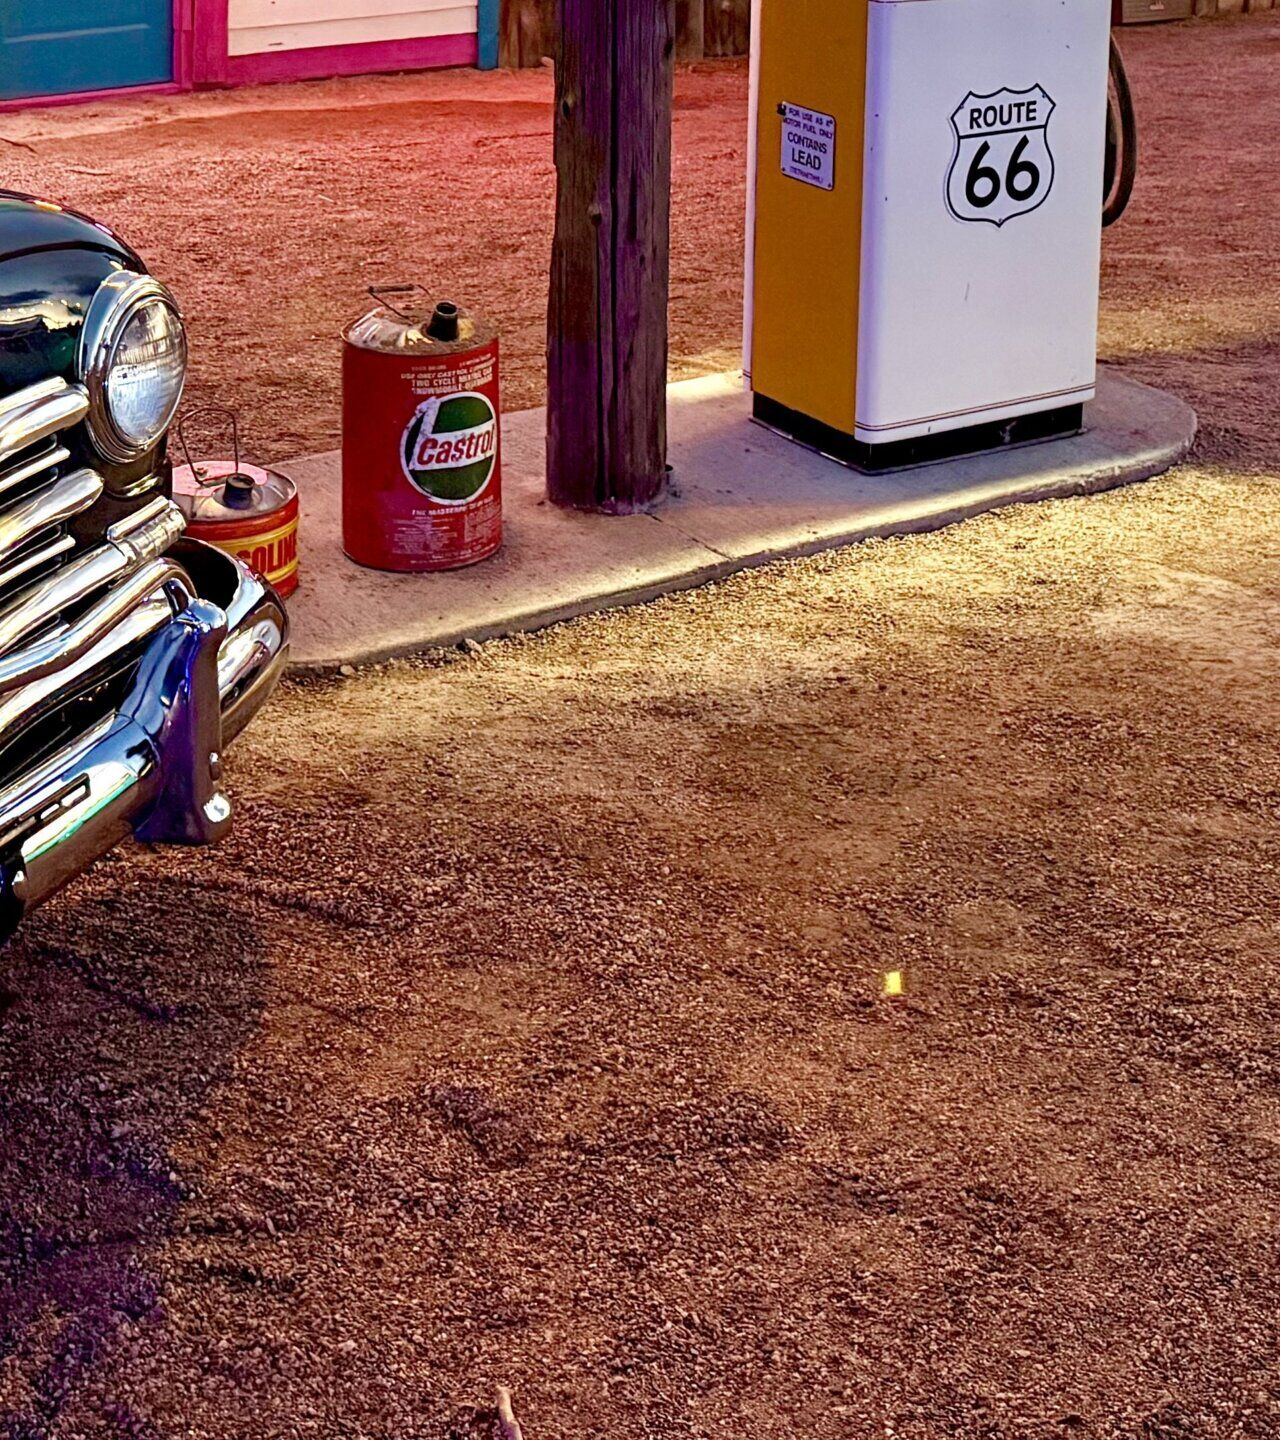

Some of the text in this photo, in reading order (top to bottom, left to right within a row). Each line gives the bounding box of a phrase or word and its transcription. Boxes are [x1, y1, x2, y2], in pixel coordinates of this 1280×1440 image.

[970, 100, 1037, 130] ROUTE
[787, 131, 827, 154] CONTAINS
[792, 147, 821, 170] LEAD
[965, 134, 1040, 208] 66
[417, 422, 495, 466] Castrol
